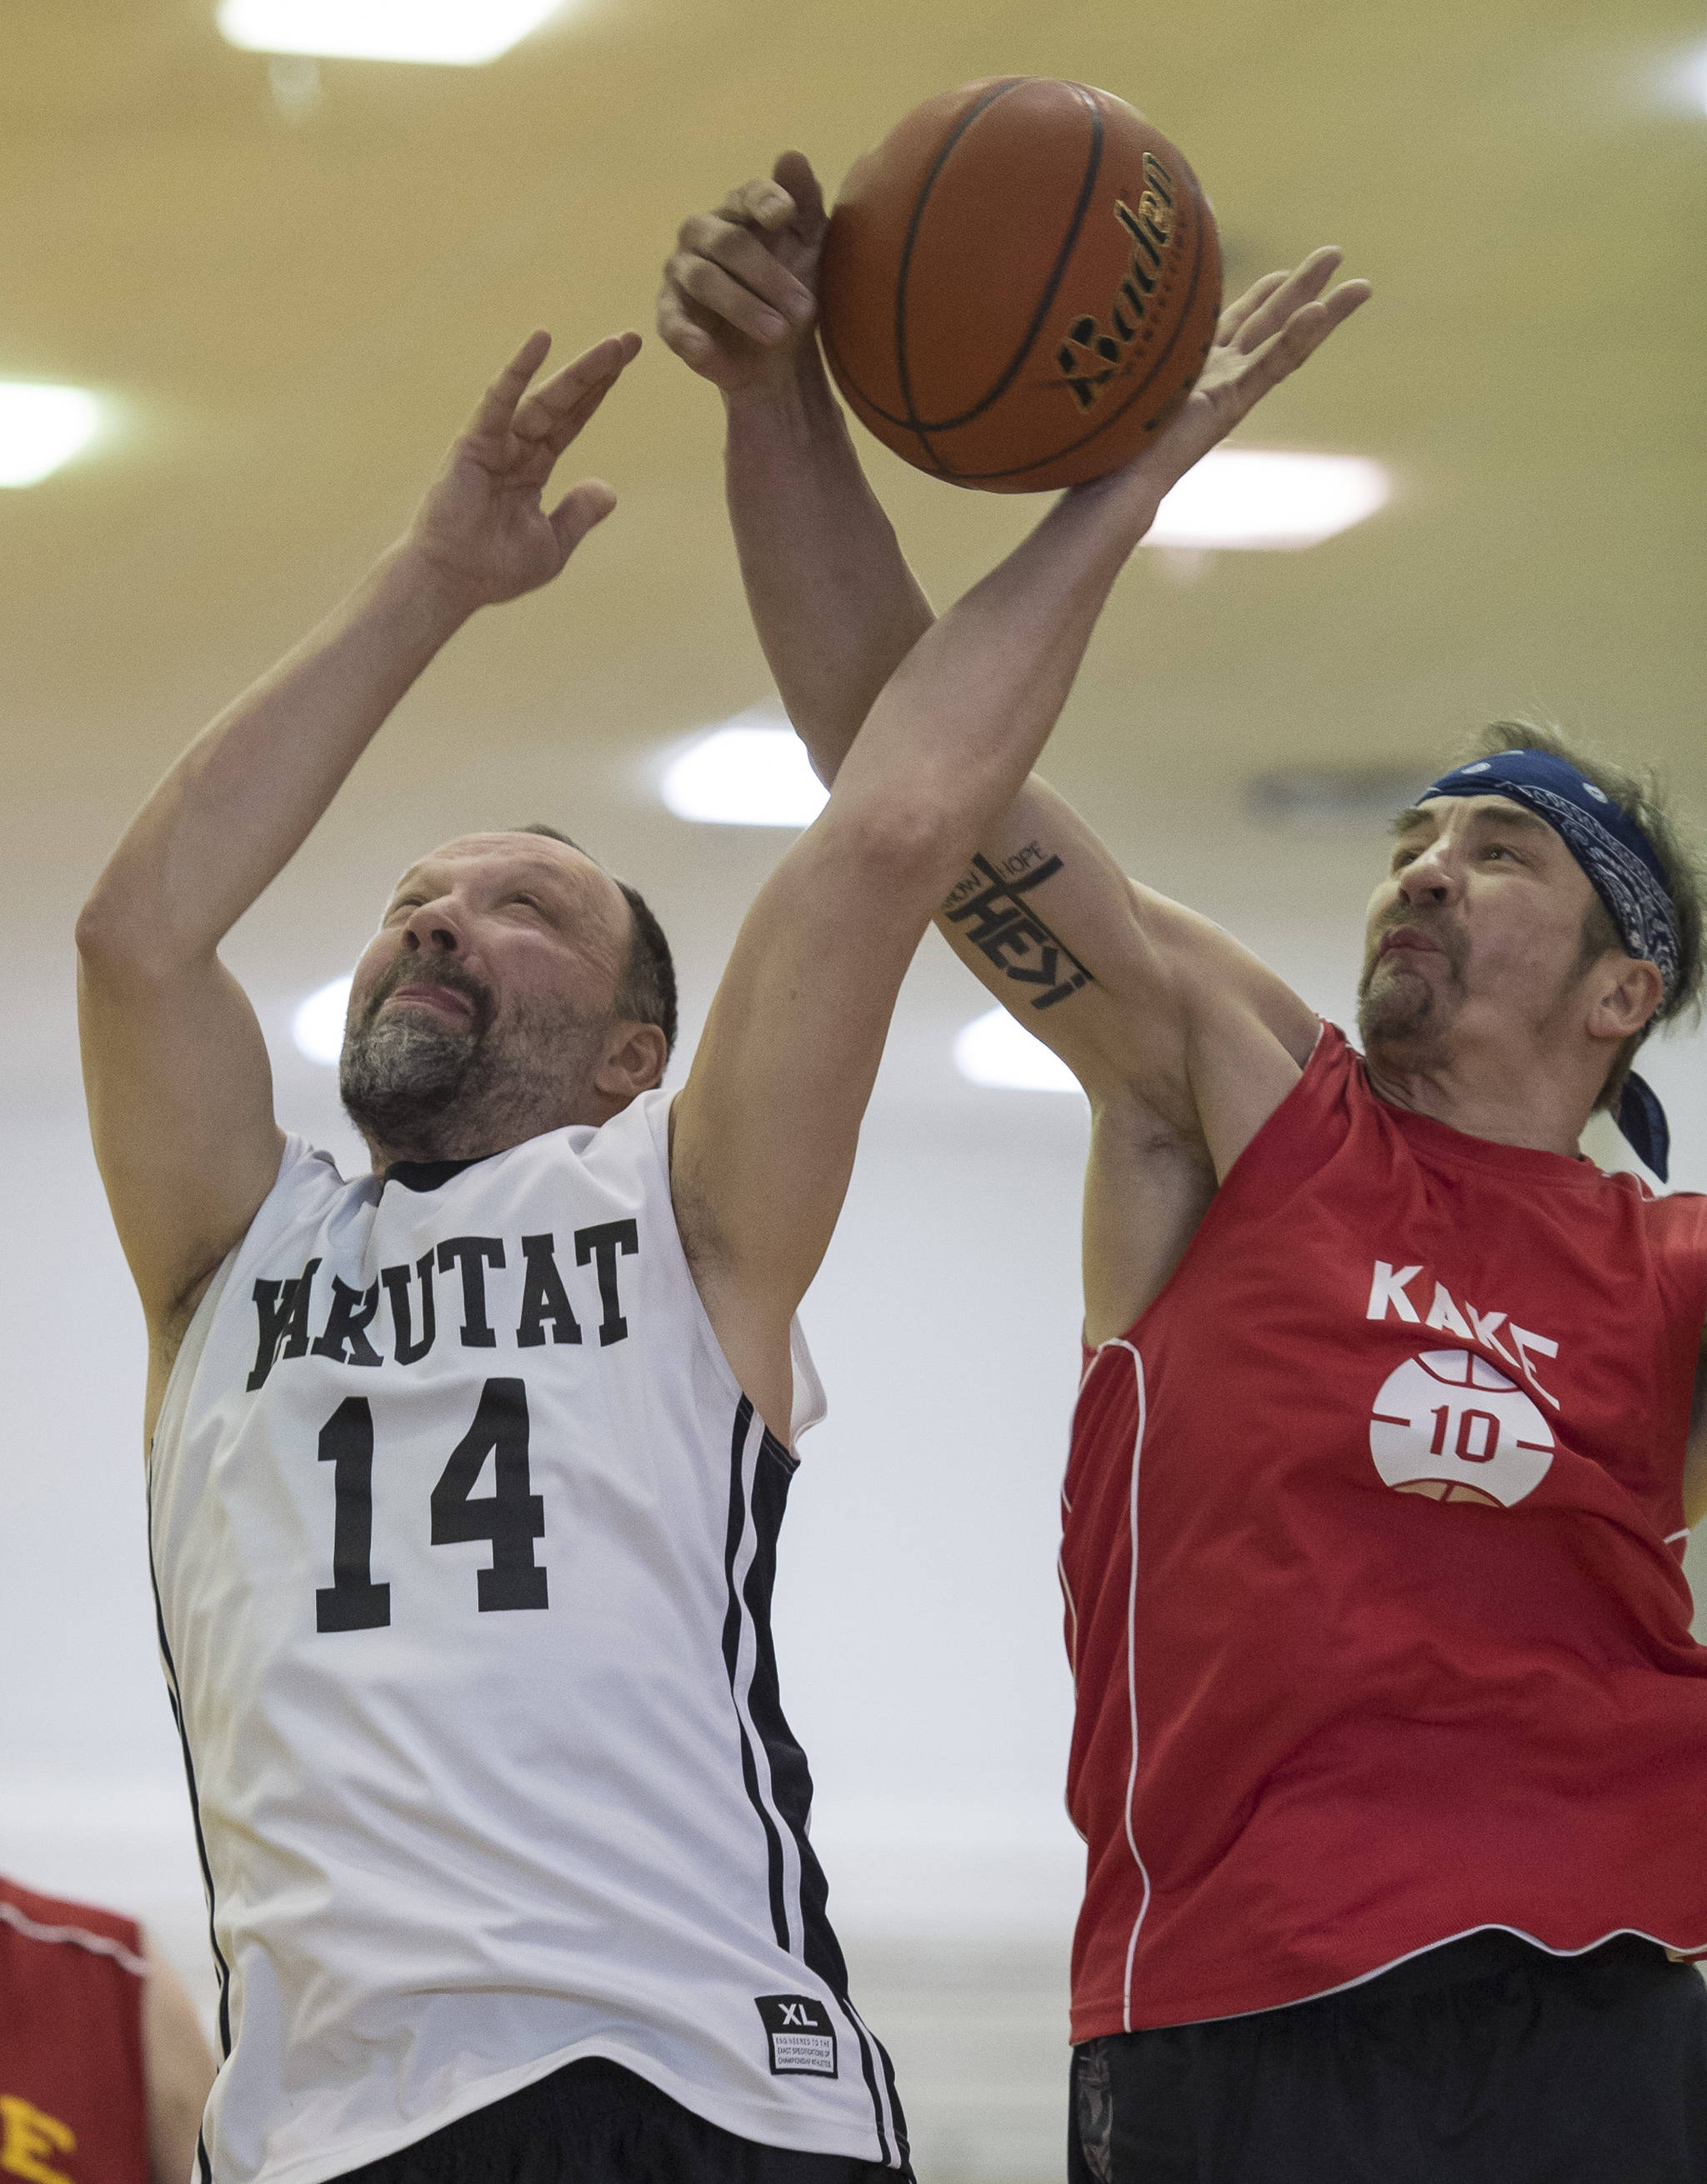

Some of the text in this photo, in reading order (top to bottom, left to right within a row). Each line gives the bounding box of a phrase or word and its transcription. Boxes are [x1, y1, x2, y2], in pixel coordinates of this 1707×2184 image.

[1366, 1259, 1560, 1412] KAKE
[1429, 1404, 1500, 1463] 10
[316, 1377, 549, 1633] 14
[777, 2002, 818, 2027] XL
